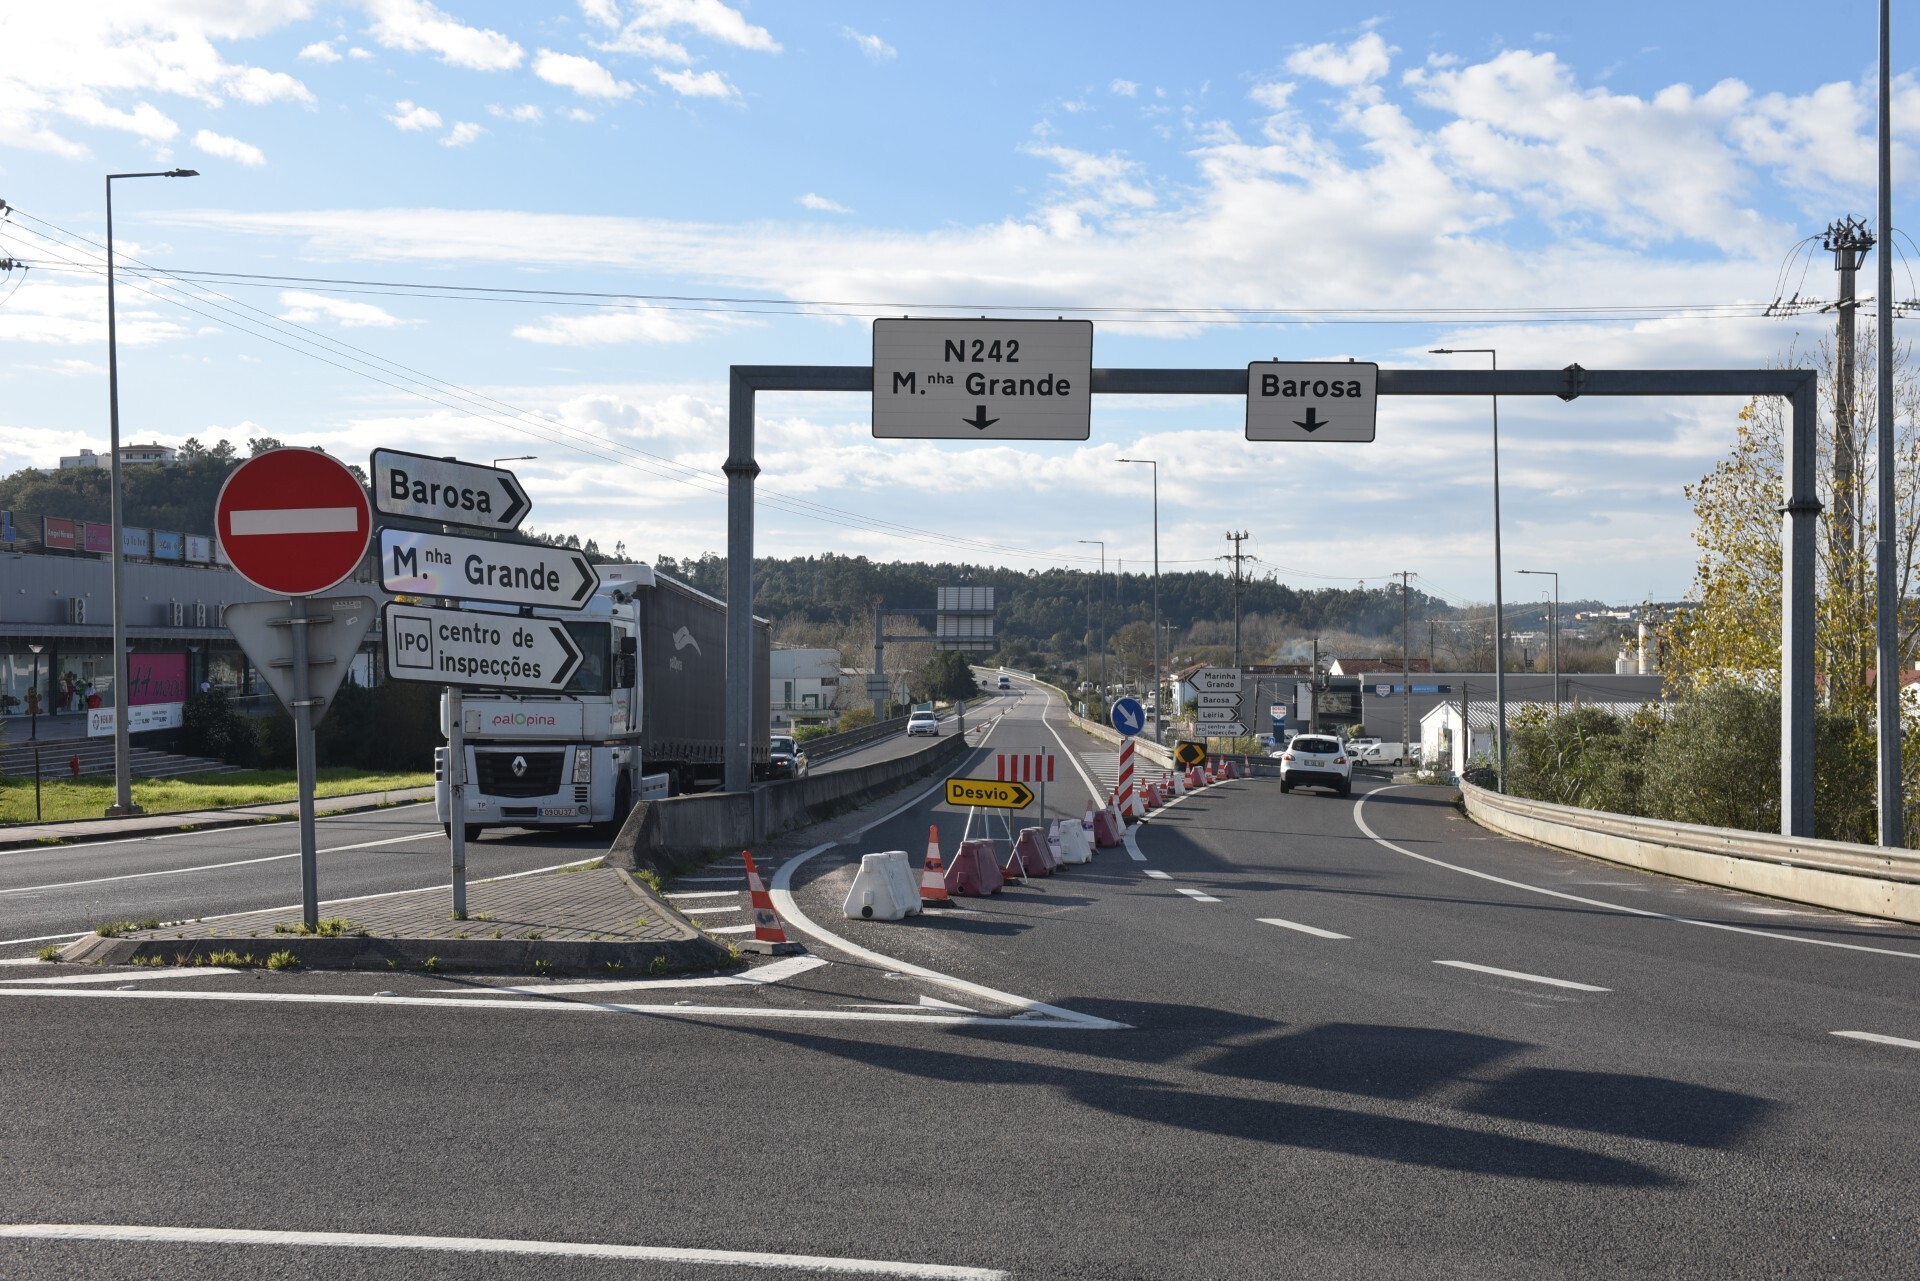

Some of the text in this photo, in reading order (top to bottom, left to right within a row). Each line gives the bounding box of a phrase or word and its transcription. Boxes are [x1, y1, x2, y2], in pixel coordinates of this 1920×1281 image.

[944, 339, 1020, 363] N242
[965, 372, 1071, 396] Grande
[1261, 373, 1362, 398] Barosa
[390, 468, 492, 514] Barosa
[464, 554, 560, 592] Grande
[398, 632, 429, 653] IPO
[438, 622, 534, 649] centro de
[439, 650, 542, 683] inspecções
[1204, 672, 1236, 680] Marinha
[1203, 696, 1230, 704] Barosa
[1202, 711, 1224, 719] Leiria
[952, 784, 1009, 801] Desvio
